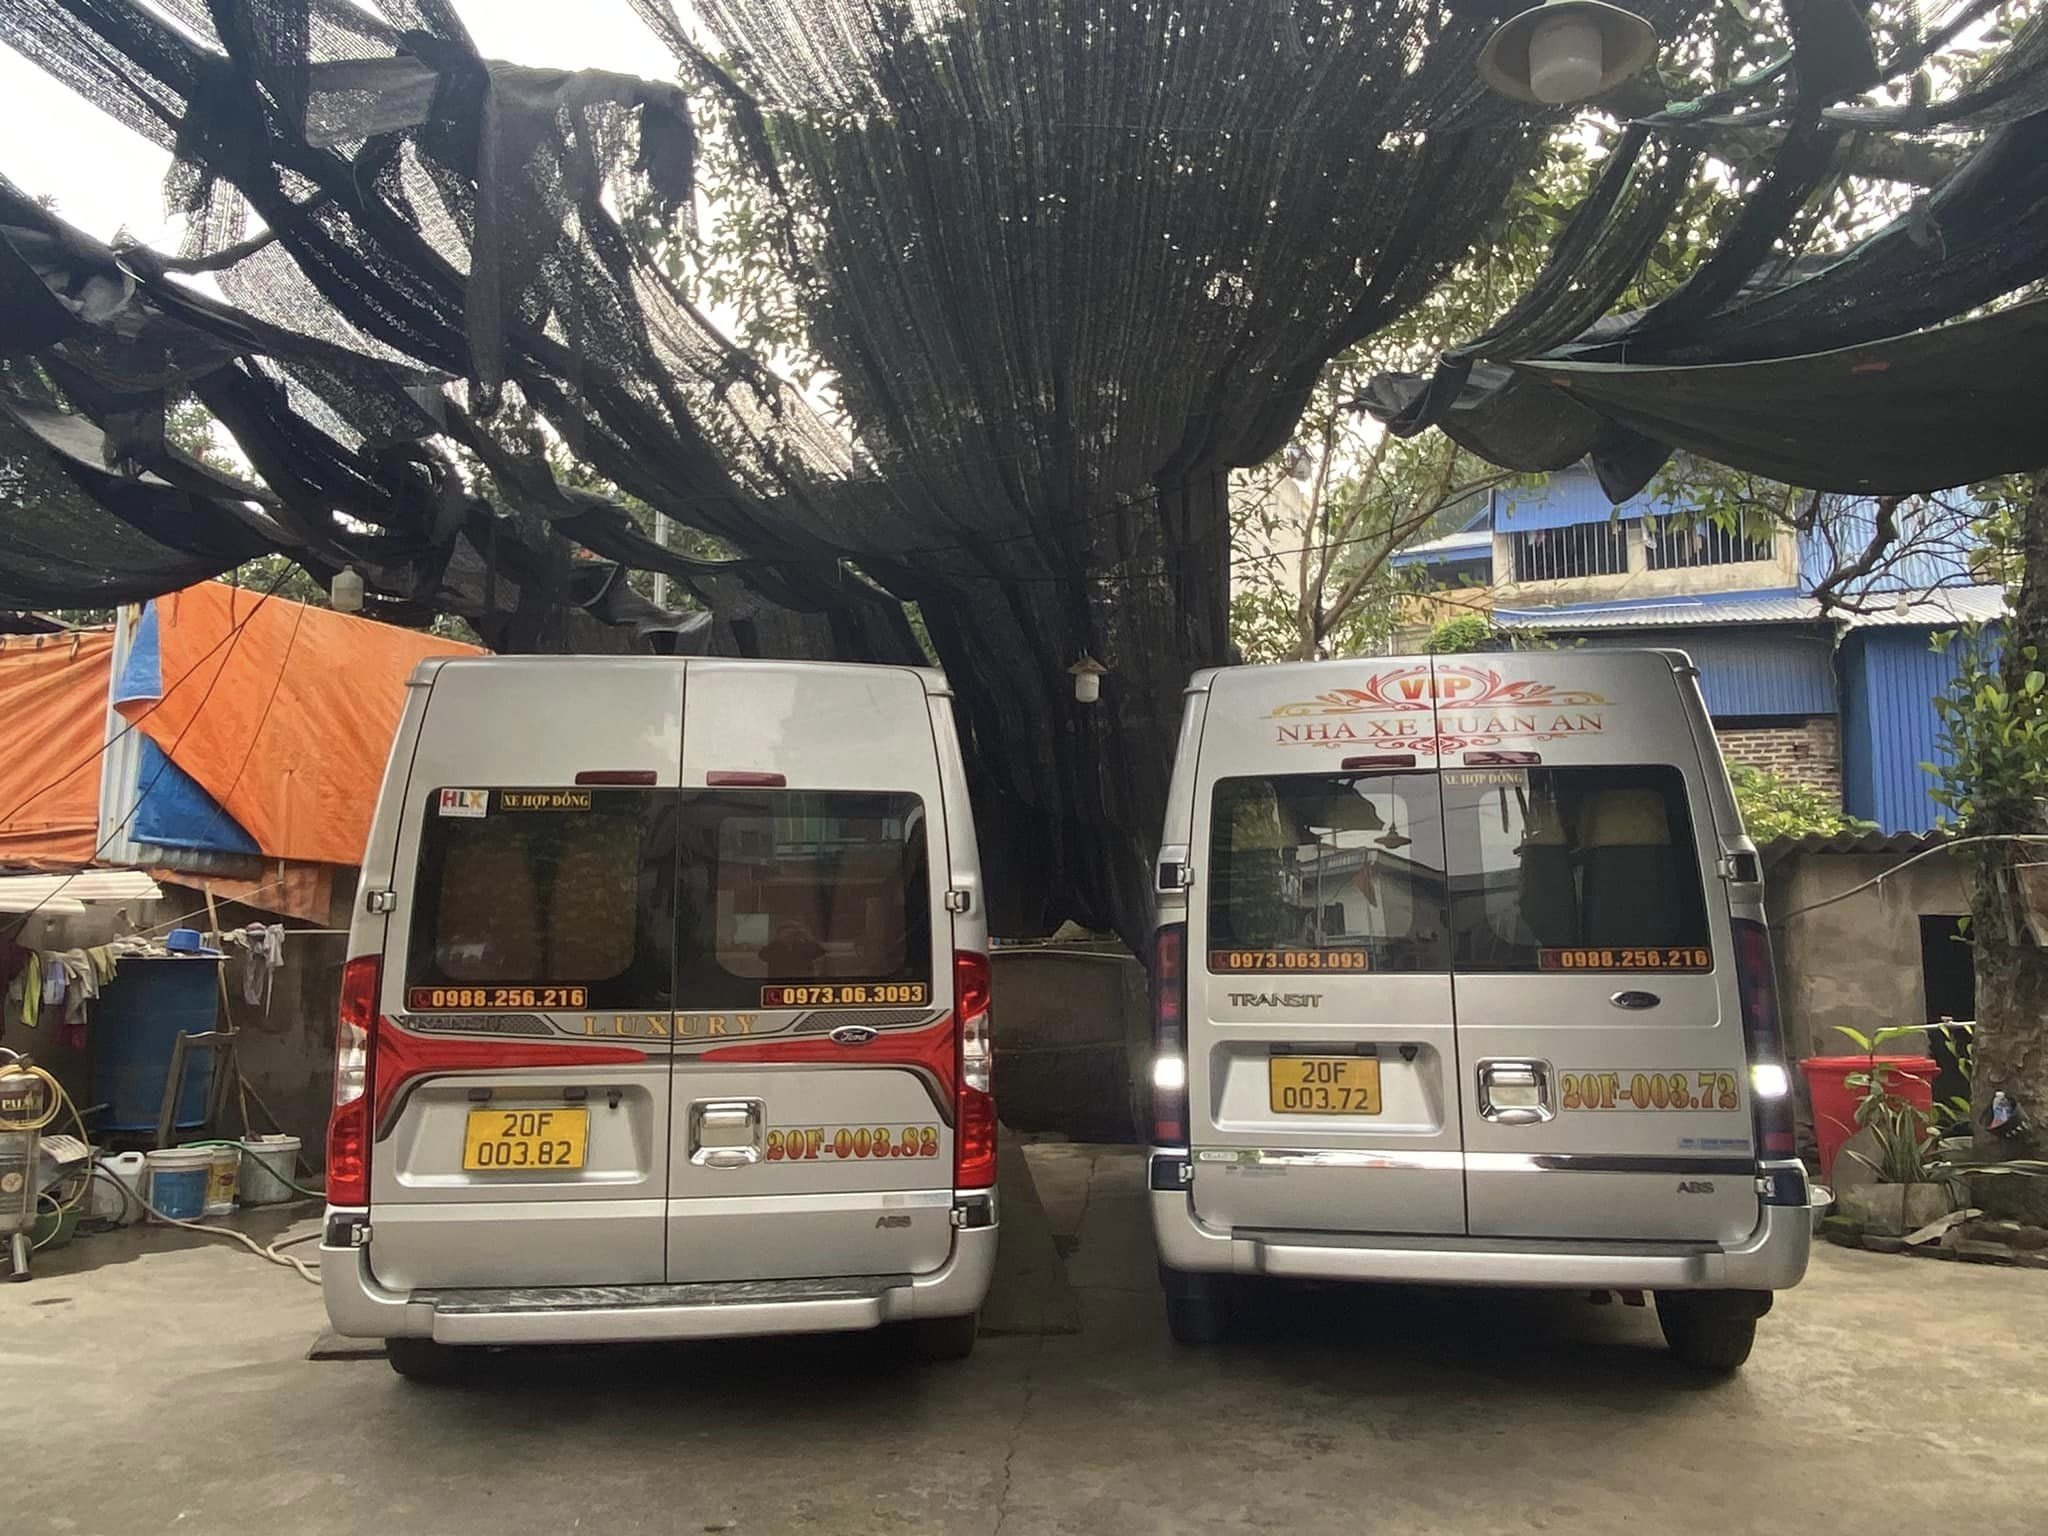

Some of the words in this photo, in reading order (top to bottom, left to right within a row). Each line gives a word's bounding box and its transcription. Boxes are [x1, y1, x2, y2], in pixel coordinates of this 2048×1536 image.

[1400, 678, 1471, 700] VIP
[1276, 717, 1356, 742] NHÀ
[1368, 719, 1417, 737] XE
[1550, 714, 1604, 731] AN
[442, 791, 482, 808] HLX
[504, 795, 521, 807] XE
[1229, 952, 1365, 969] 0973.063.093
[432, 990, 583, 1006] 0988.256.216
[783, 986, 923, 1004] 0973.06.3093
[1228, 992, 1324, 1008] TRANSIT
[584, 1015, 758, 1037] LUXURY
[1302, 1061, 1347, 1083] 20F
[1283, 1087, 1368, 1110] 003.72
[1561, 1072, 1738, 1109] 20F-003.72
[502, 1113, 553, 1137] 20F
[478, 1141, 571, 1165] 003.82
[767, 1126, 938, 1161] 20F-003.82
